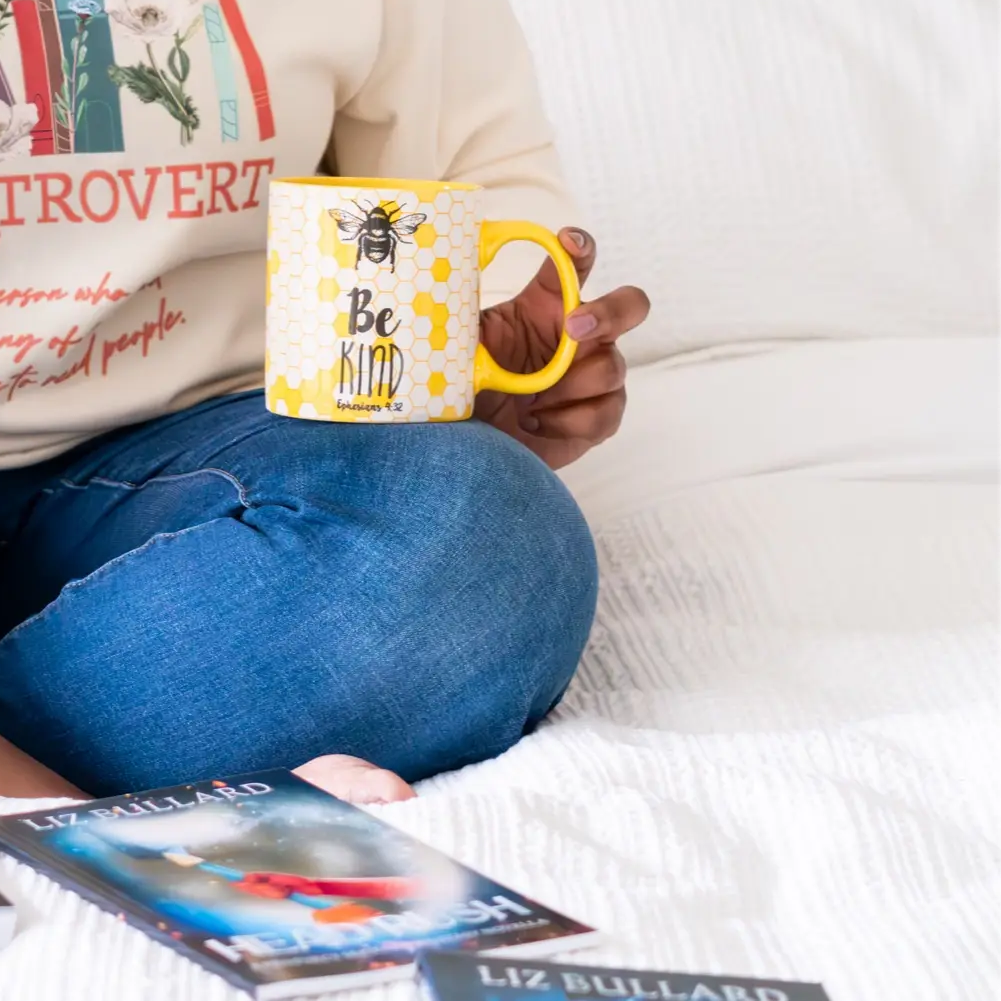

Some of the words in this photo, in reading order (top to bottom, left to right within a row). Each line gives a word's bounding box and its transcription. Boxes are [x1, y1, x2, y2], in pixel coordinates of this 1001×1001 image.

[75, 272, 131, 305] who
[347, 287, 402, 338] Be
[48, 325, 83, 359] of
[101, 297, 187, 377] people.
[20, 812, 88, 832] LIZ
[89, 782, 273, 822] BULLARD
[476, 965, 551, 990] LIZ
[560, 971, 789, 1001] BULLARD
